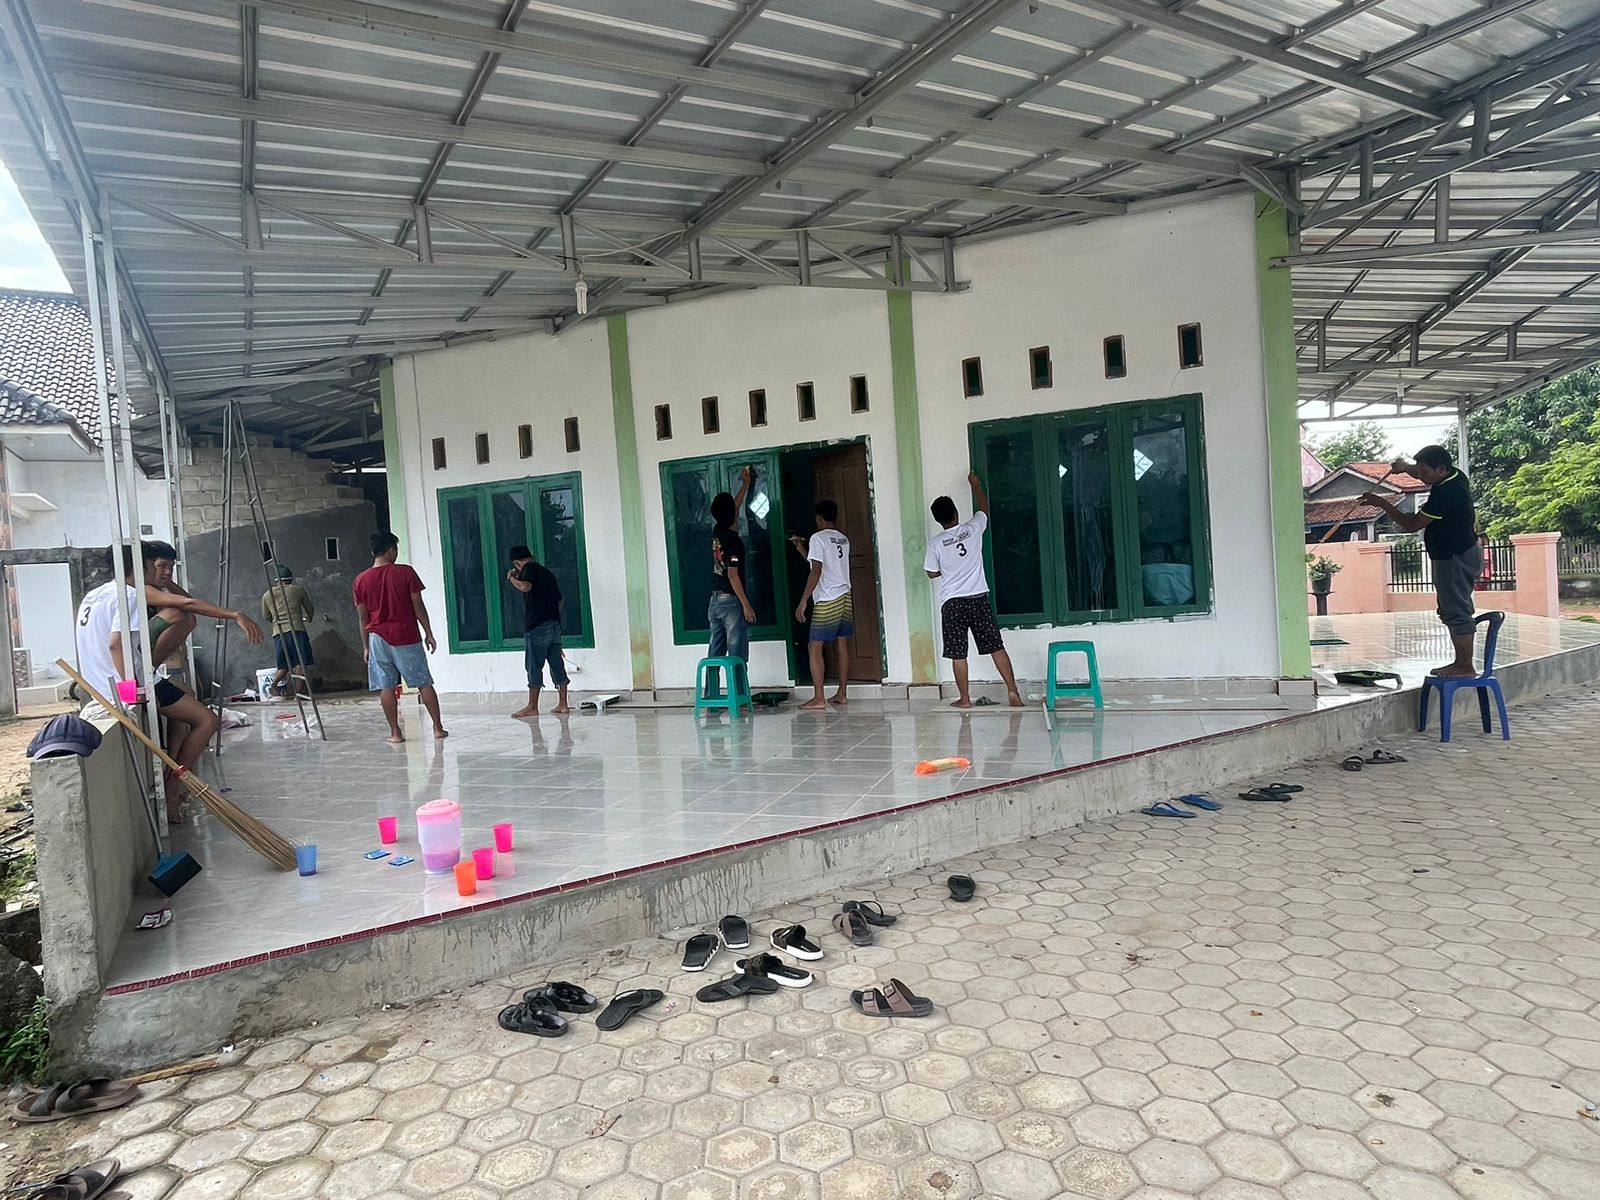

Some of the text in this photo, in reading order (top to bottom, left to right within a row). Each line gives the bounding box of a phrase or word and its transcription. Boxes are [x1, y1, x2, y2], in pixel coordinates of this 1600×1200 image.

[836, 545, 844, 559] 3
[956, 542, 967, 557] 3
[80, 605, 91, 627] 3
